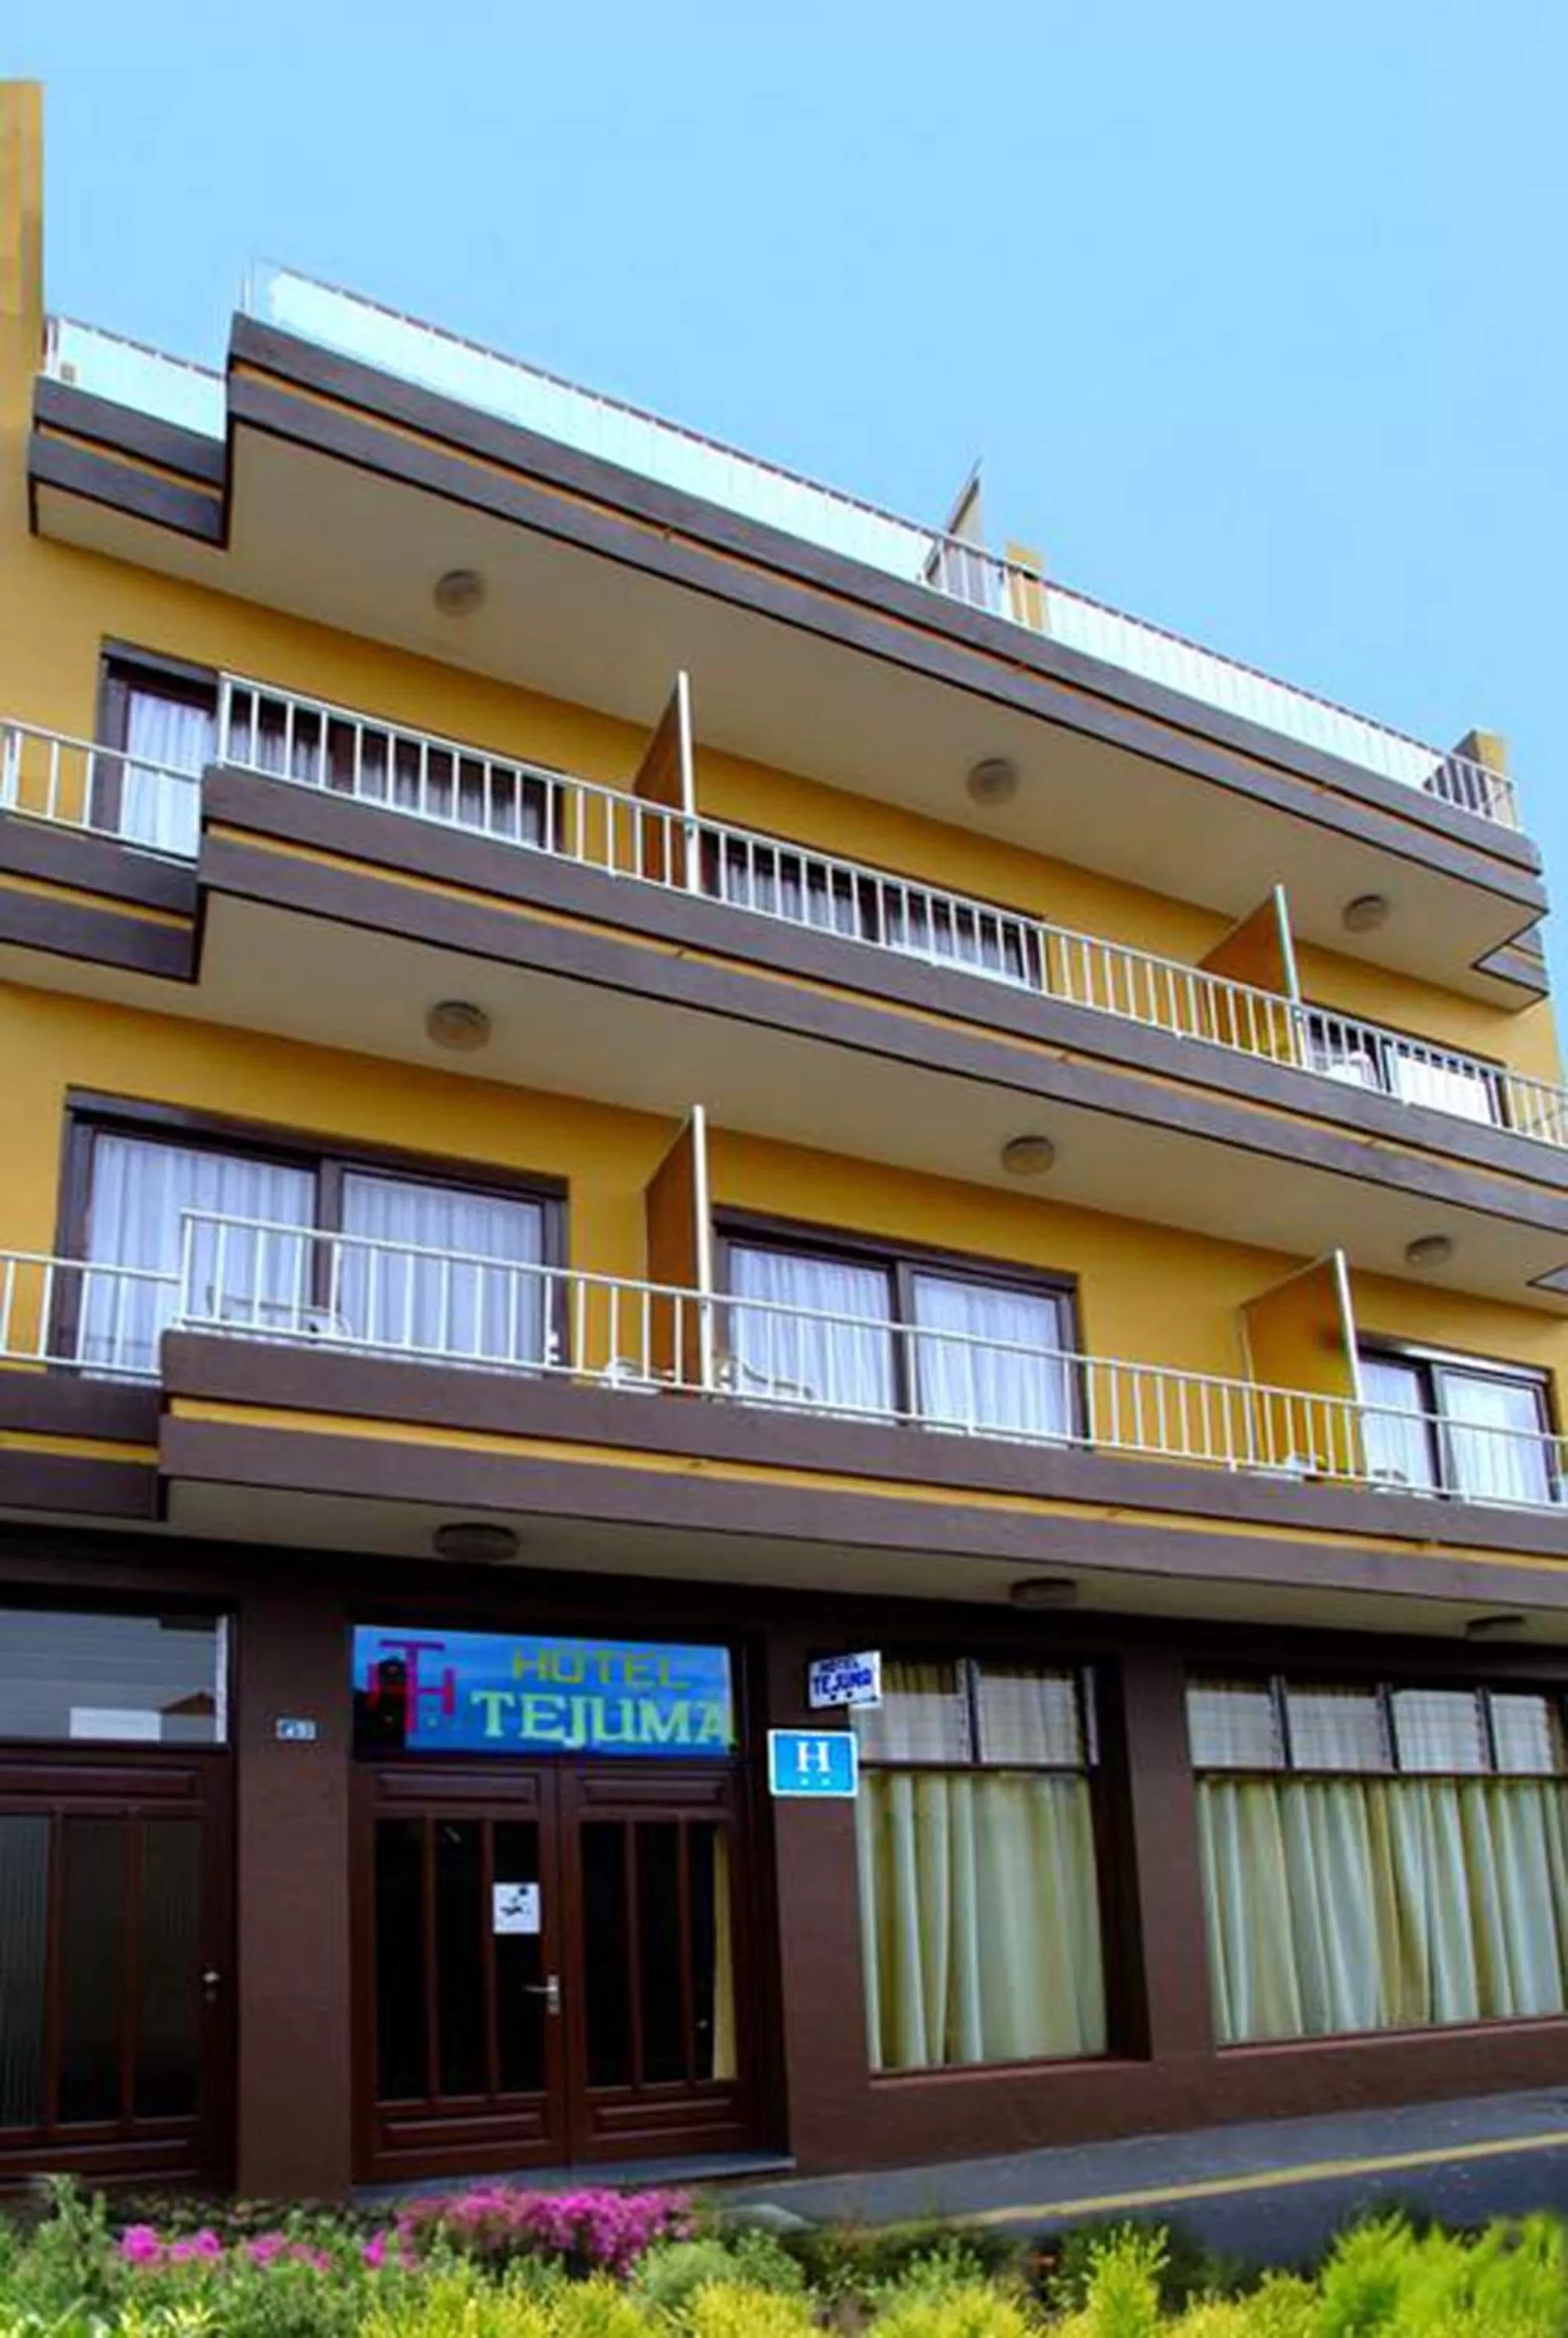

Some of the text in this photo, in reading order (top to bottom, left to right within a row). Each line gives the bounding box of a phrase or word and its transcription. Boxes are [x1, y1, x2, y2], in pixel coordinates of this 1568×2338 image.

[511, 1644, 690, 1690] HOTEL
[470, 1690, 737, 1750] TEJUMA
[796, 1740, 831, 1773] H
